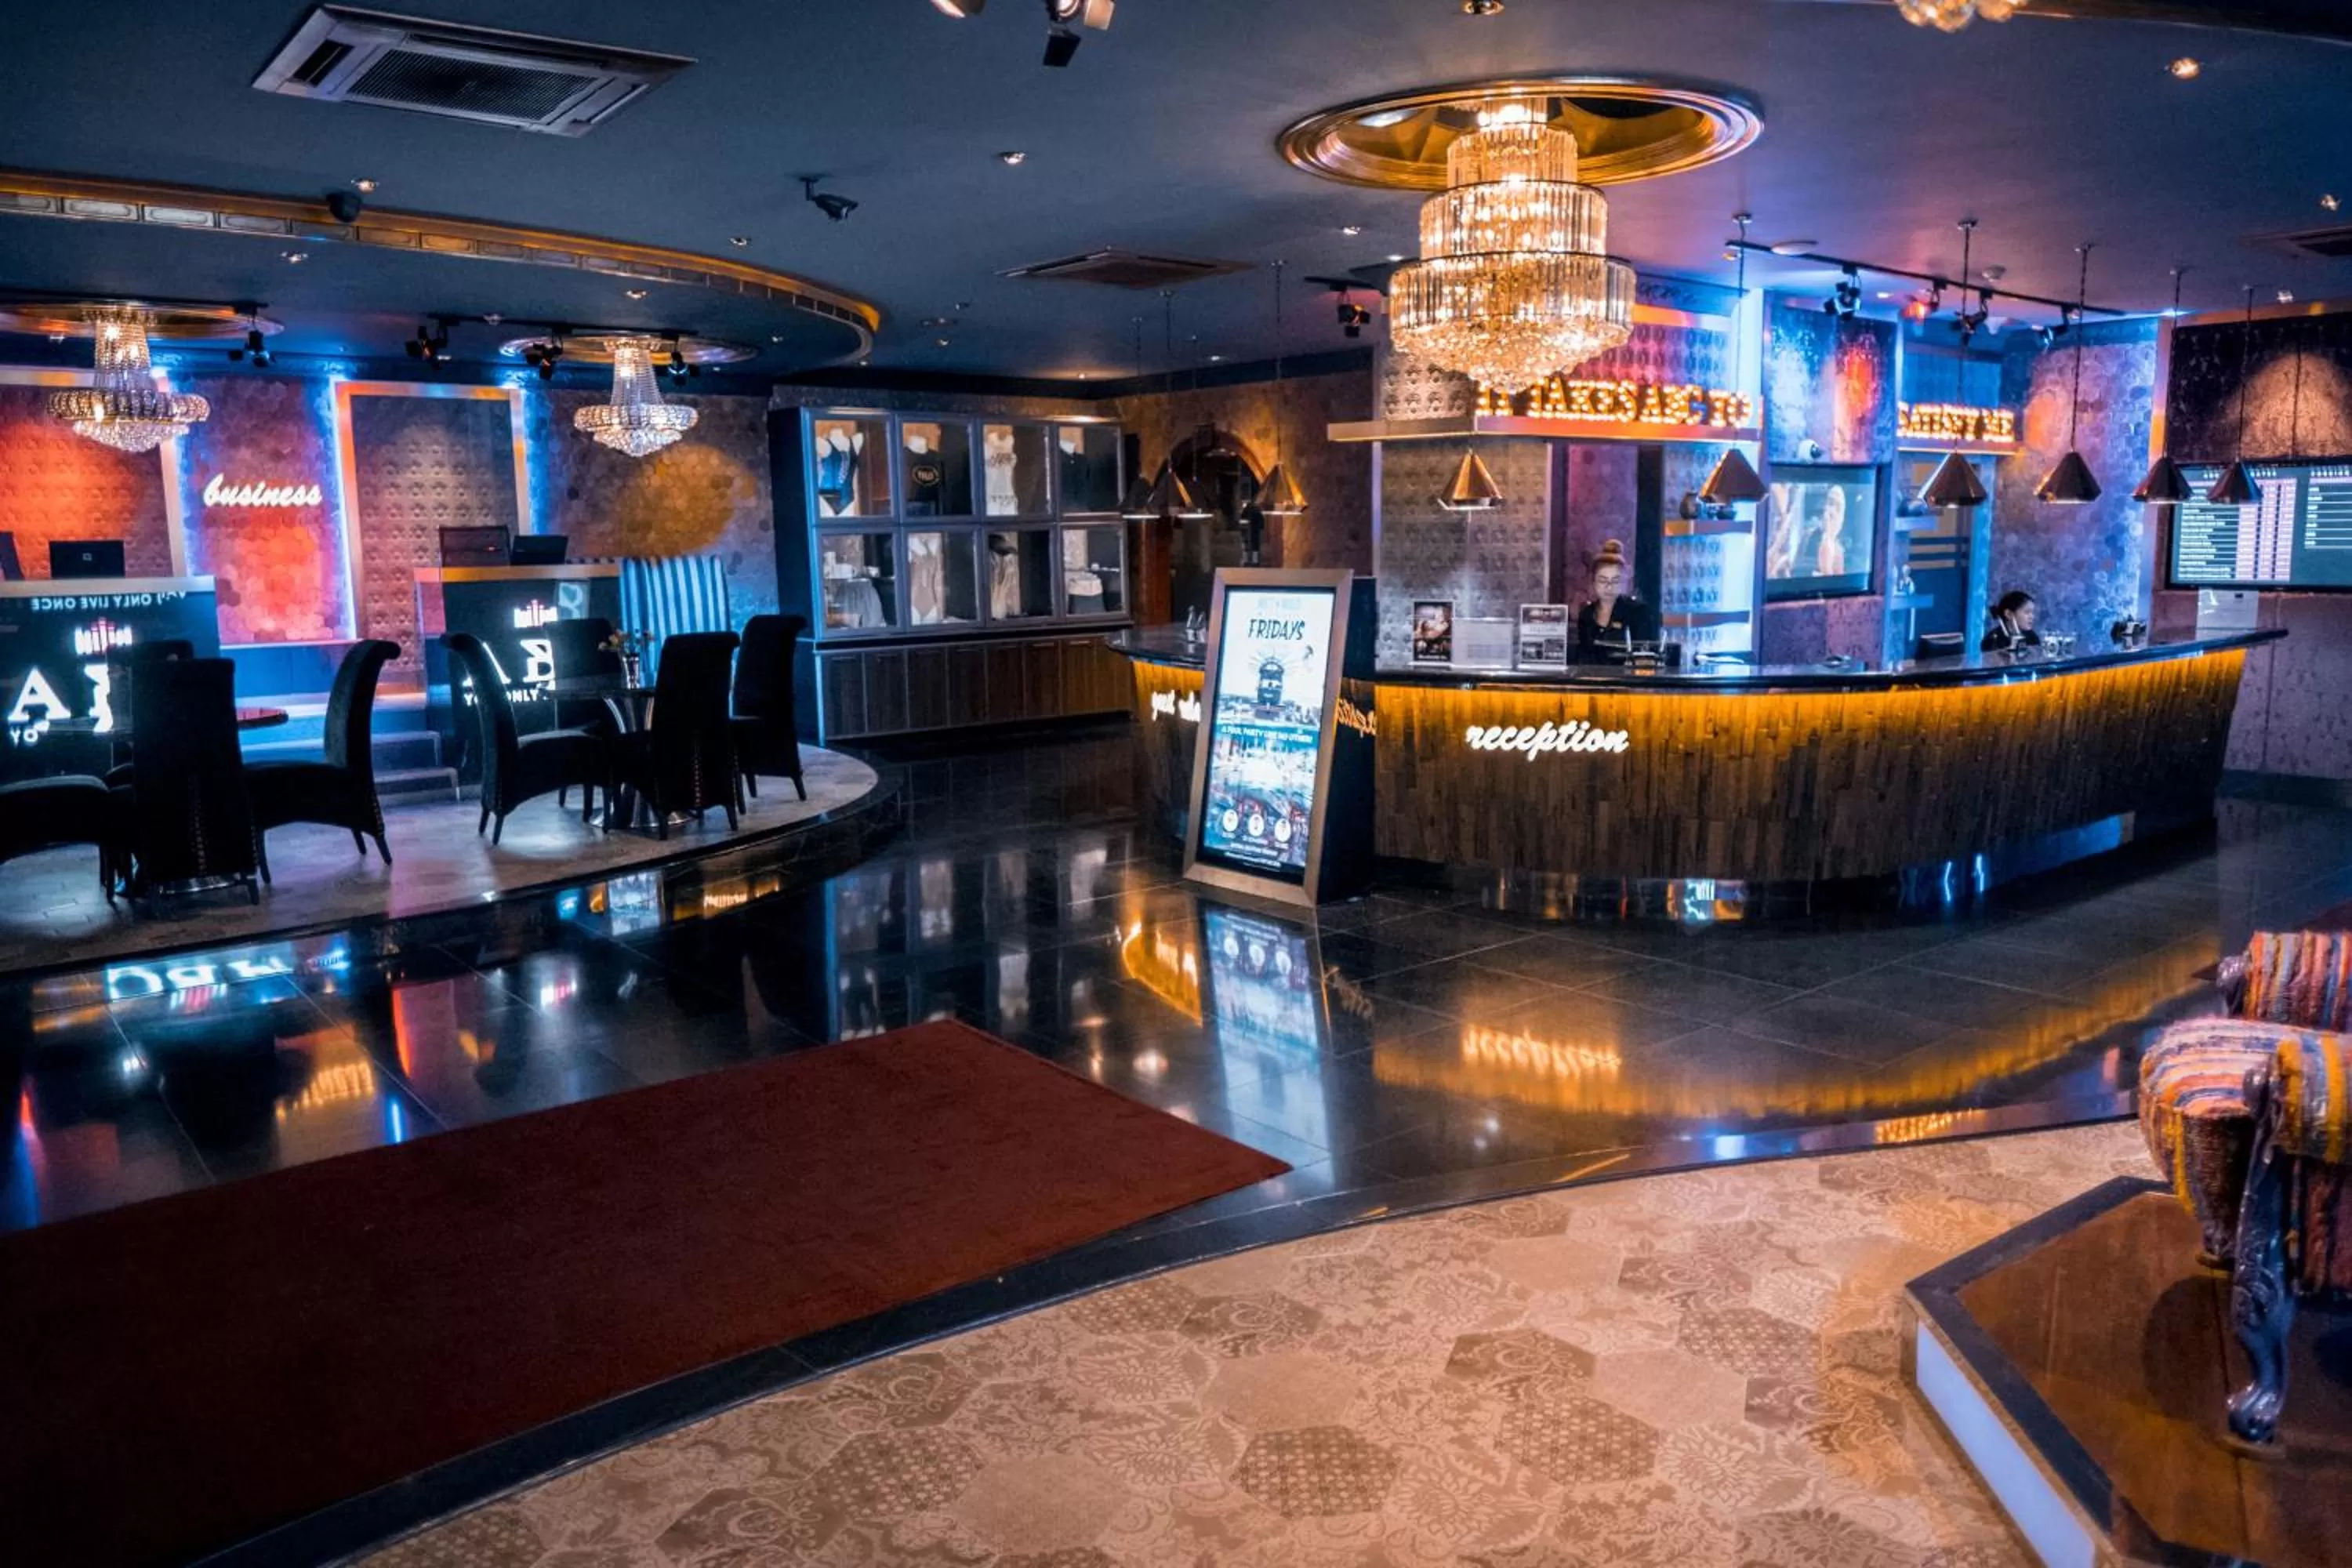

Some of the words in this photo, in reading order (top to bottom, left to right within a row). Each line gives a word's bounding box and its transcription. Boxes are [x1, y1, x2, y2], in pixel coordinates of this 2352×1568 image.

[1526, 376, 1638, 423] TAKES
[1639, 383, 1704, 426] ABC
[1708, 389, 1752, 429] TO
[1981, 407, 2015, 443] ME
[203, 472, 323, 507] business
[1248, 618, 1305, 641] FRIDAYS
[1465, 719, 1631, 762] reception
